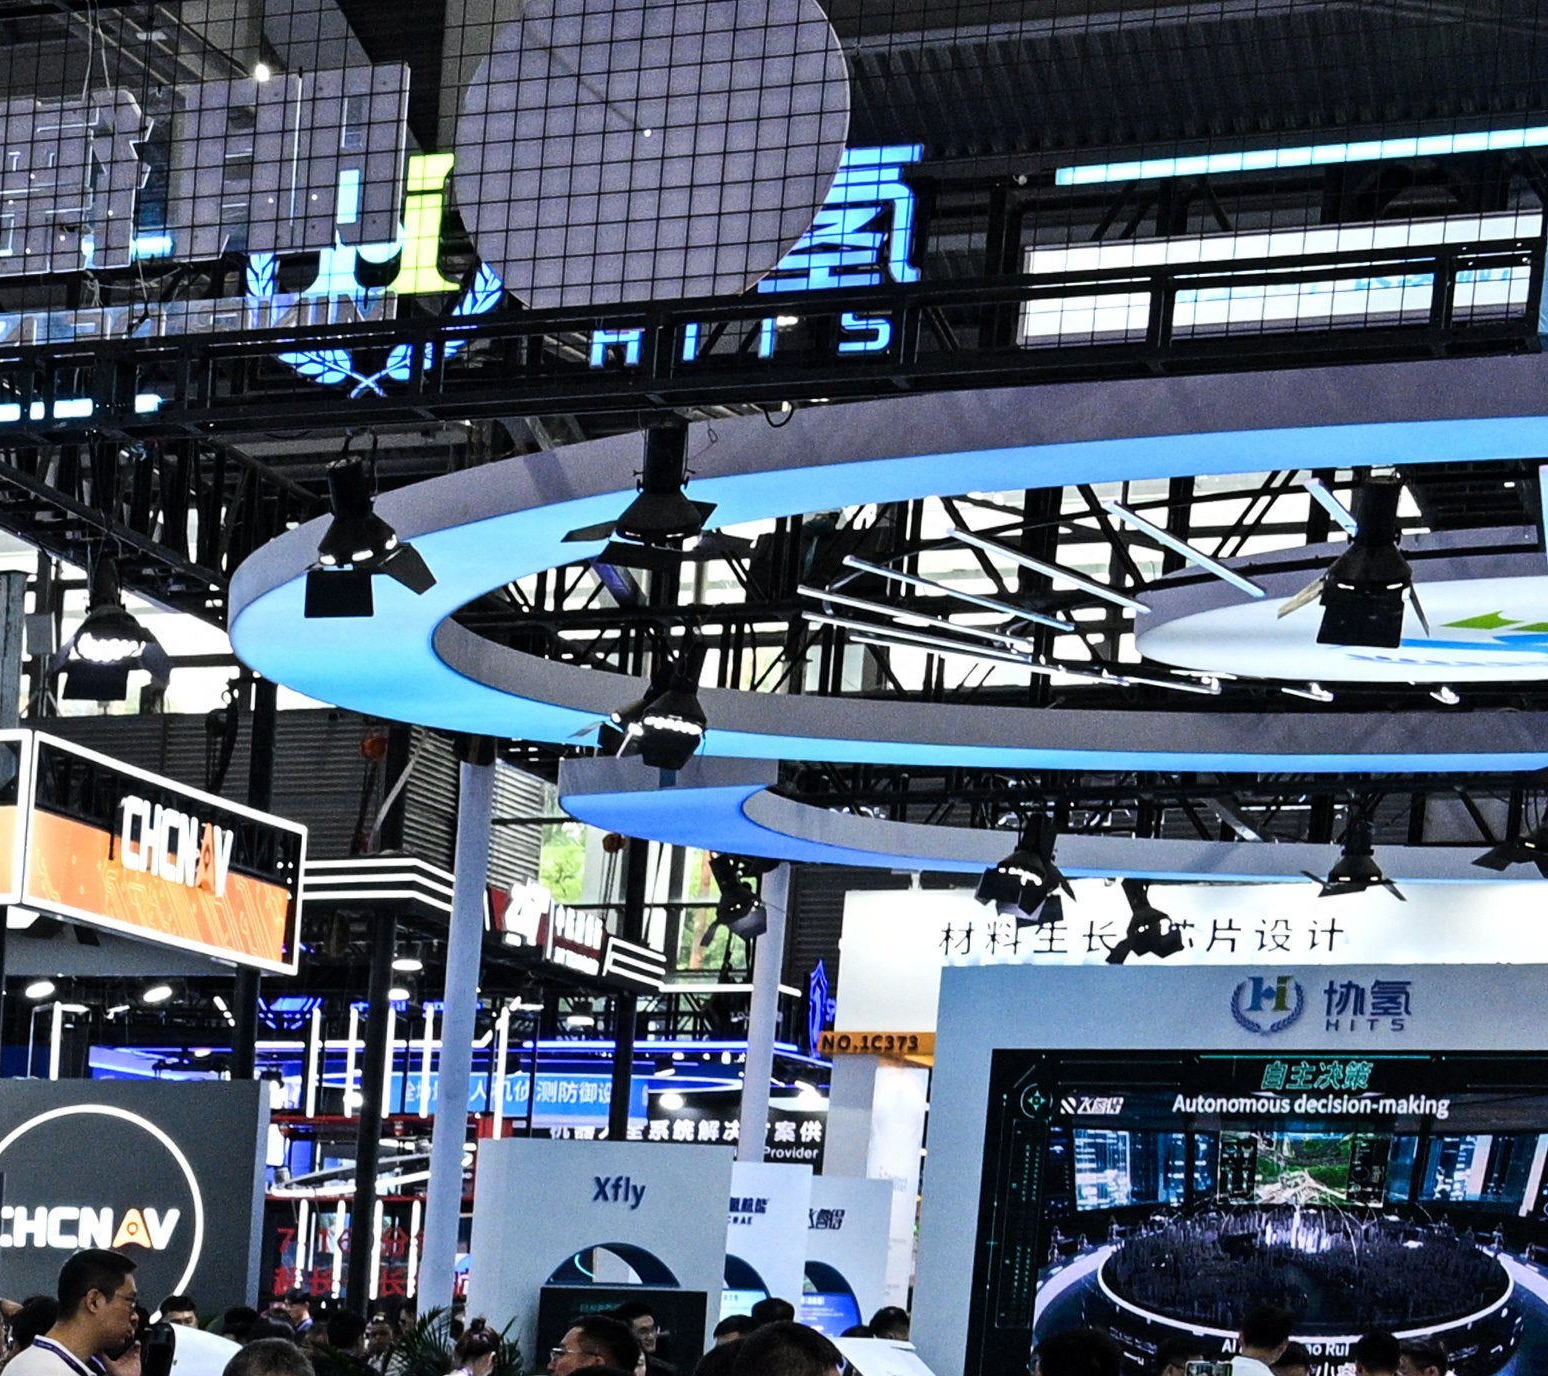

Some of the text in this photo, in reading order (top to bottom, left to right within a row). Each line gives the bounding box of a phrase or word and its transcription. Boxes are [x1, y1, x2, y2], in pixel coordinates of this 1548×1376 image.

[120, 794, 234, 898] CHCNAV
[1324, 979, 1412, 1017] 协氢
[1324, 1017, 1406, 1033] HITS
[822, 1034, 920, 1051] NO.1C373
[1172, 1094, 1450, 1119] Autonomous decision-making
[592, 1175, 646, 1210] Xfly
